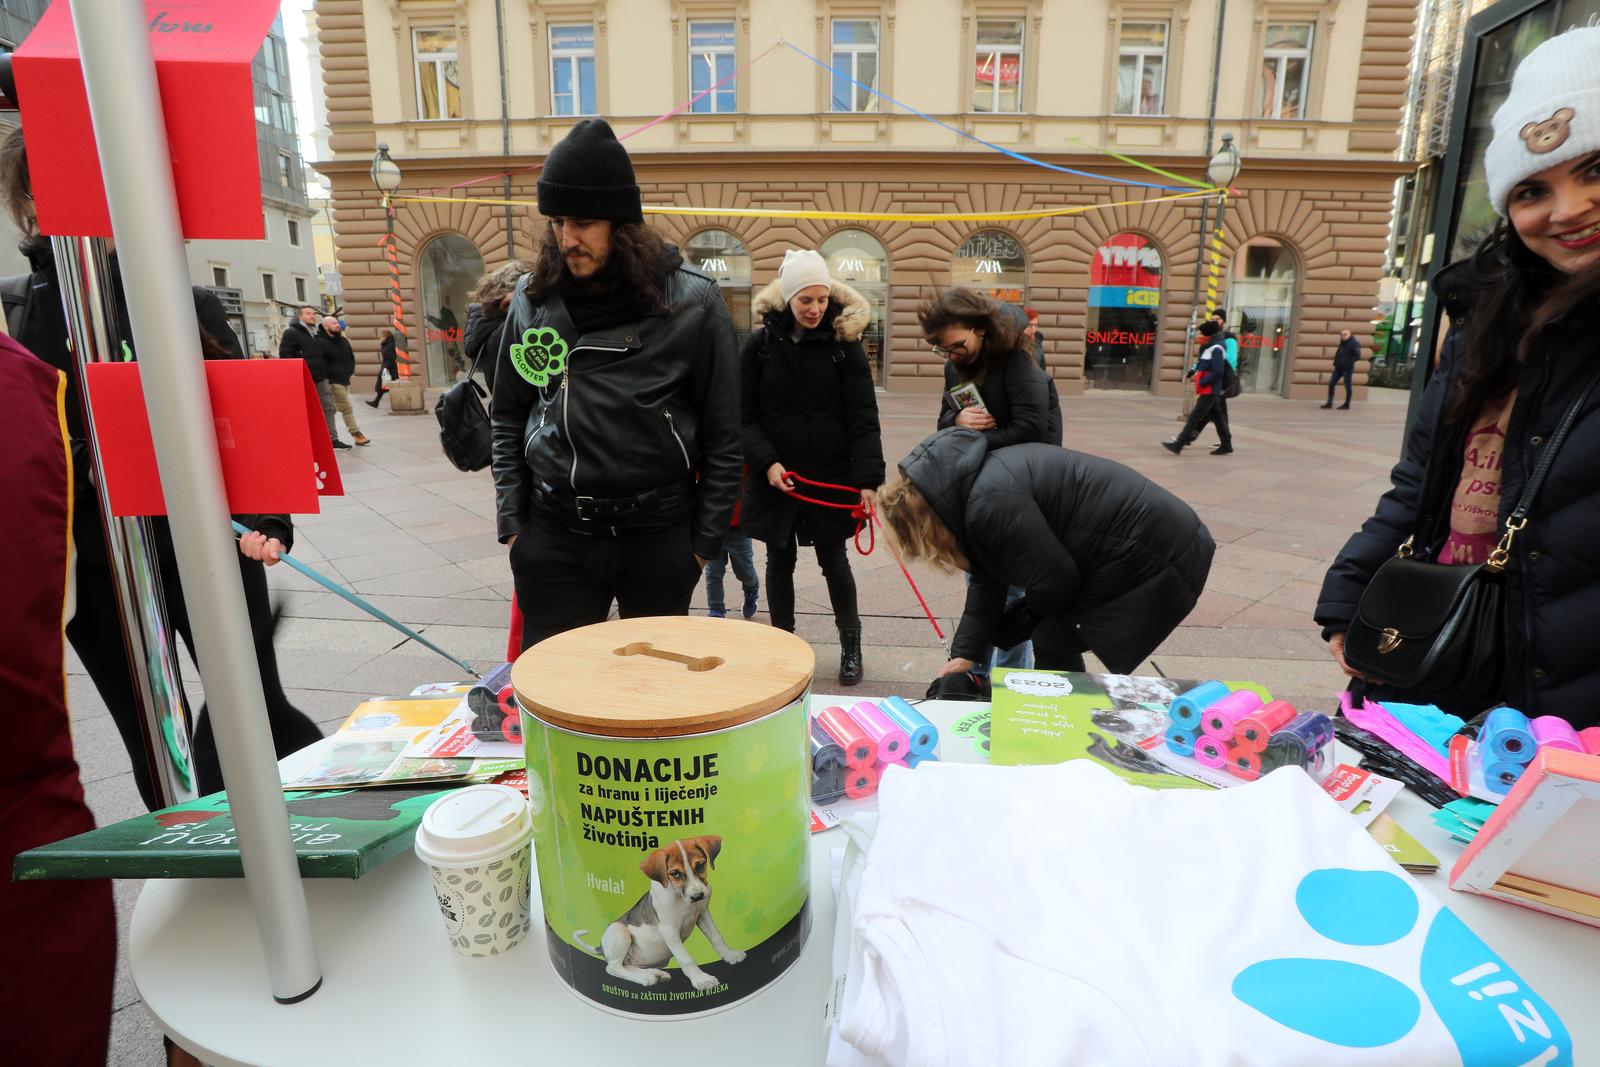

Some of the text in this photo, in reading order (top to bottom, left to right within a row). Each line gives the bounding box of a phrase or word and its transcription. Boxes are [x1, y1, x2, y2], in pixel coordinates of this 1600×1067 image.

[701, 258, 727, 272] ZARA
[837, 258, 864, 272] ZARA
[975, 260, 1003, 273] ZARA
[515, 348, 544, 381] VOLONTER
[1465, 479, 1502, 496] ps
[1010, 678, 1065, 689] 2023
[956, 712, 992, 733] ONTER
[576, 752, 719, 783] DONACIJE
[578, 783, 718, 804] za hranu i liječenje
[580, 803, 705, 827] NAPUŠTENIH
[583, 823, 659, 852] životinja
[586, 872, 625, 895] Hvala!
[601, 983, 629, 998] DRUŠTVO
[640, 991, 667, 1001] ZAŠTITU
[669, 990, 704, 1001] ŽIVOTINJA
